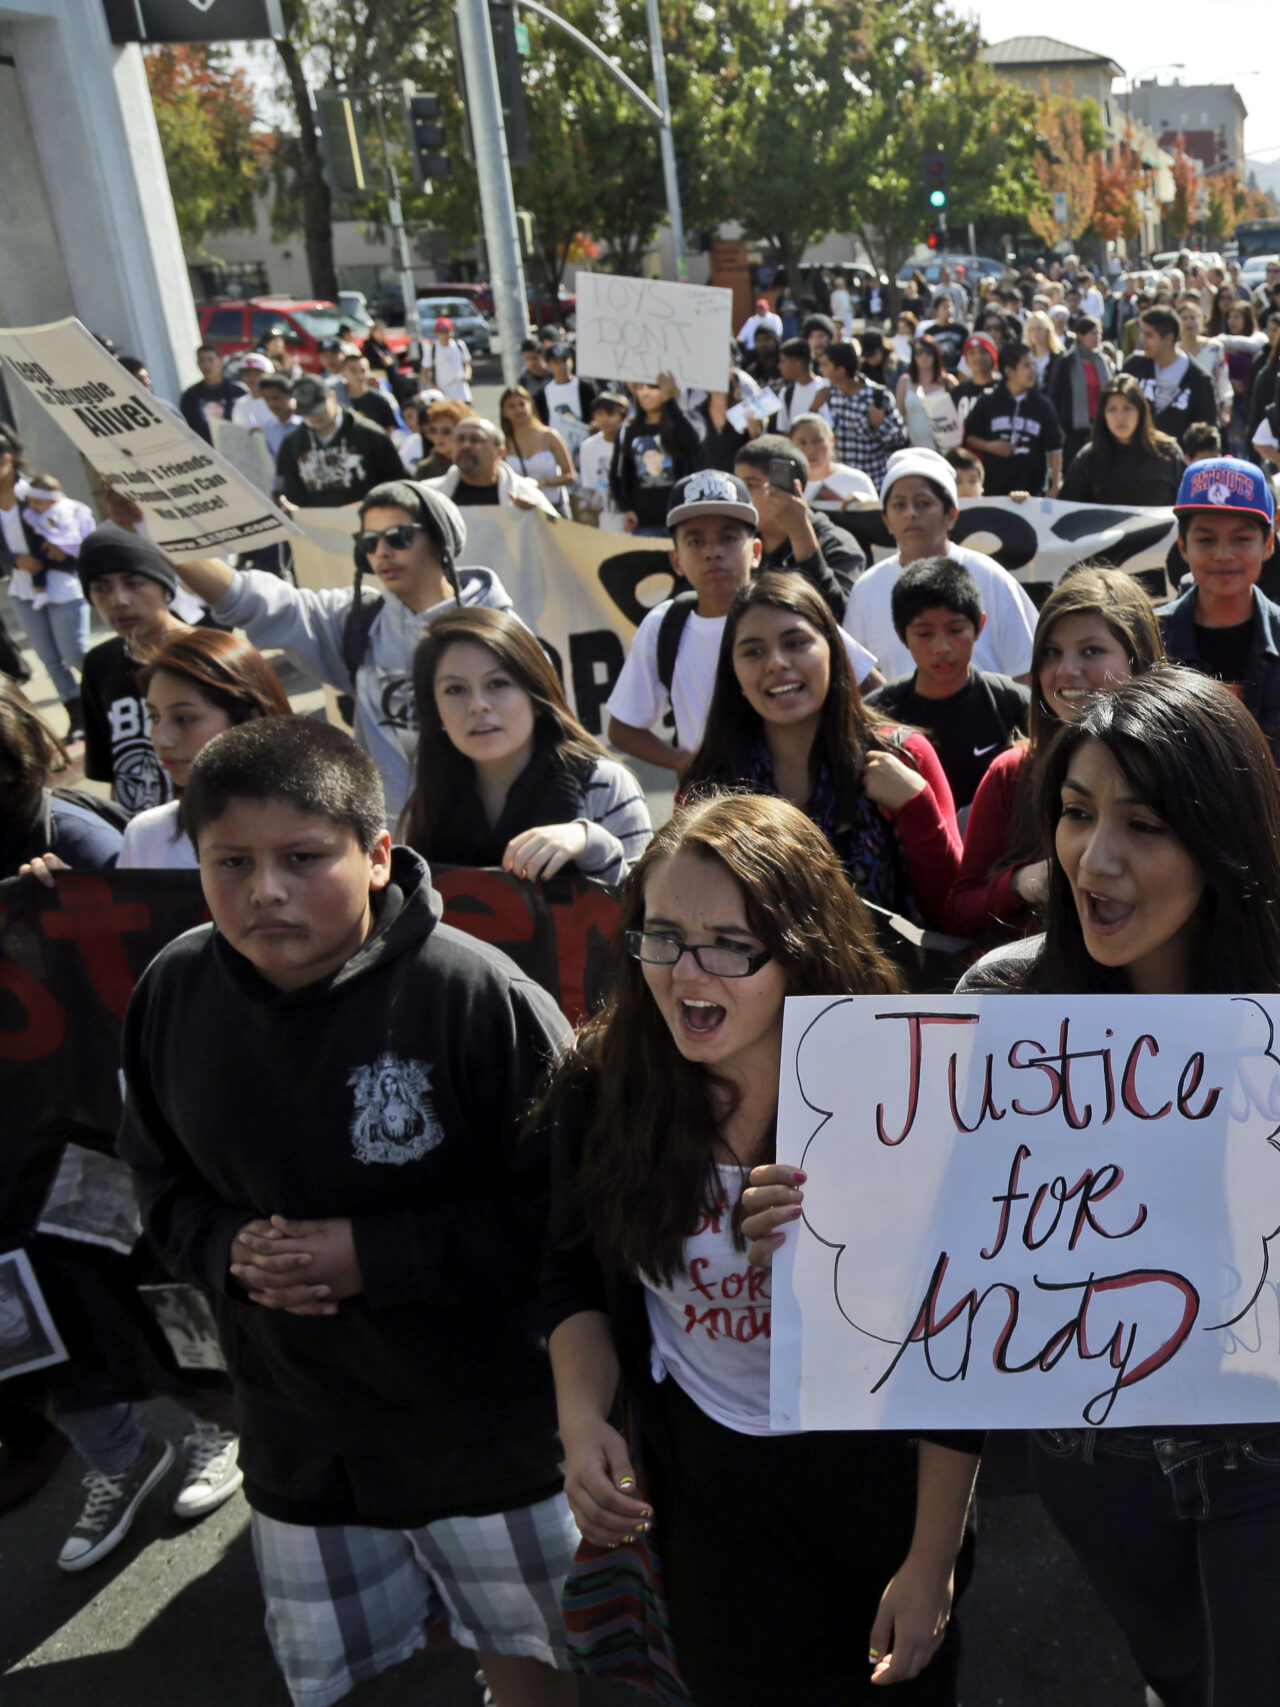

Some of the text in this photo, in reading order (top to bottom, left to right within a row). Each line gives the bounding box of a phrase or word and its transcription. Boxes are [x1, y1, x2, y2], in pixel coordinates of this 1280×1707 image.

[583, 277, 676, 319] TOYS
[73, 396, 162, 438] Alive!
[158, 455, 213, 478] Friends
[194, 474, 227, 490] Can
[1191, 469, 1254, 501] PATRIOTS
[874, 1012, 1223, 1146] Justice
[870, 1250, 1202, 1425] Andy
